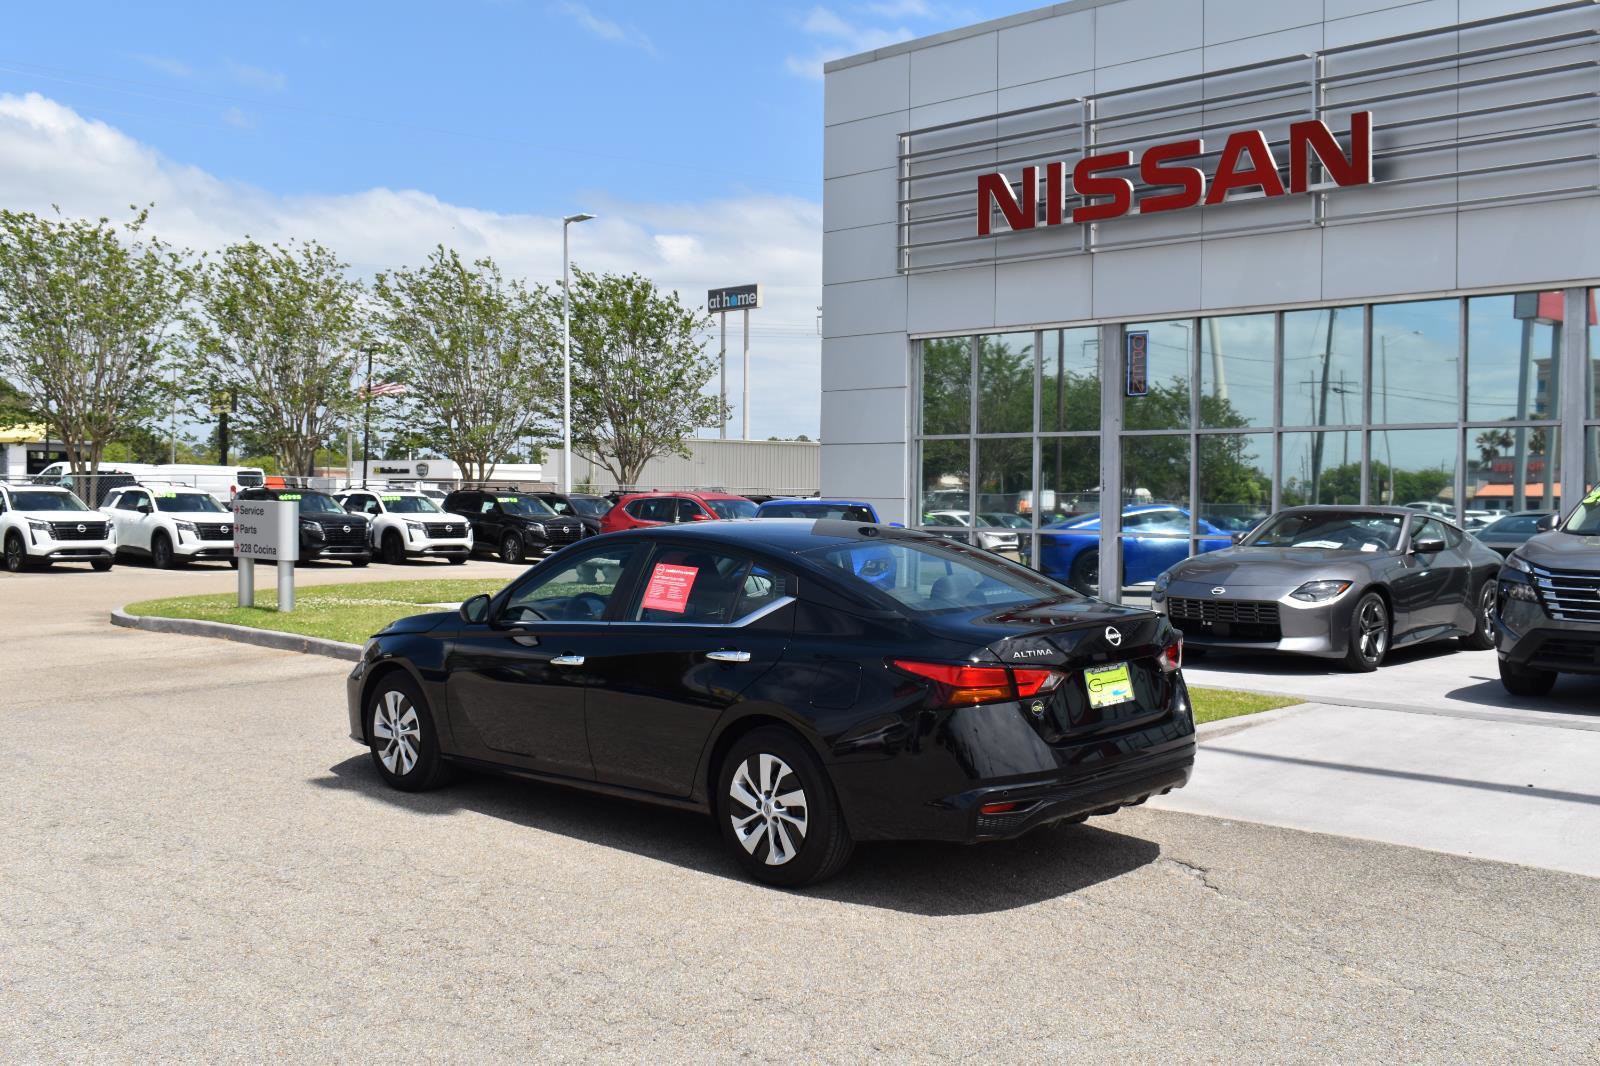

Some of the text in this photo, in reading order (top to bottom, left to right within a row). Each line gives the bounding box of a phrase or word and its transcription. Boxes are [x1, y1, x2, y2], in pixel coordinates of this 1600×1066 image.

[978, 111, 1372, 236] NISSAN
[709, 292, 756, 309] at home
[1133, 336, 1145, 392] OPEN
[240, 505, 264, 516] Service
[240, 524, 257, 534] Parts
[240, 543, 277, 555] 228 Cocina
[1013, 649, 1053, 659] ALTIMA
